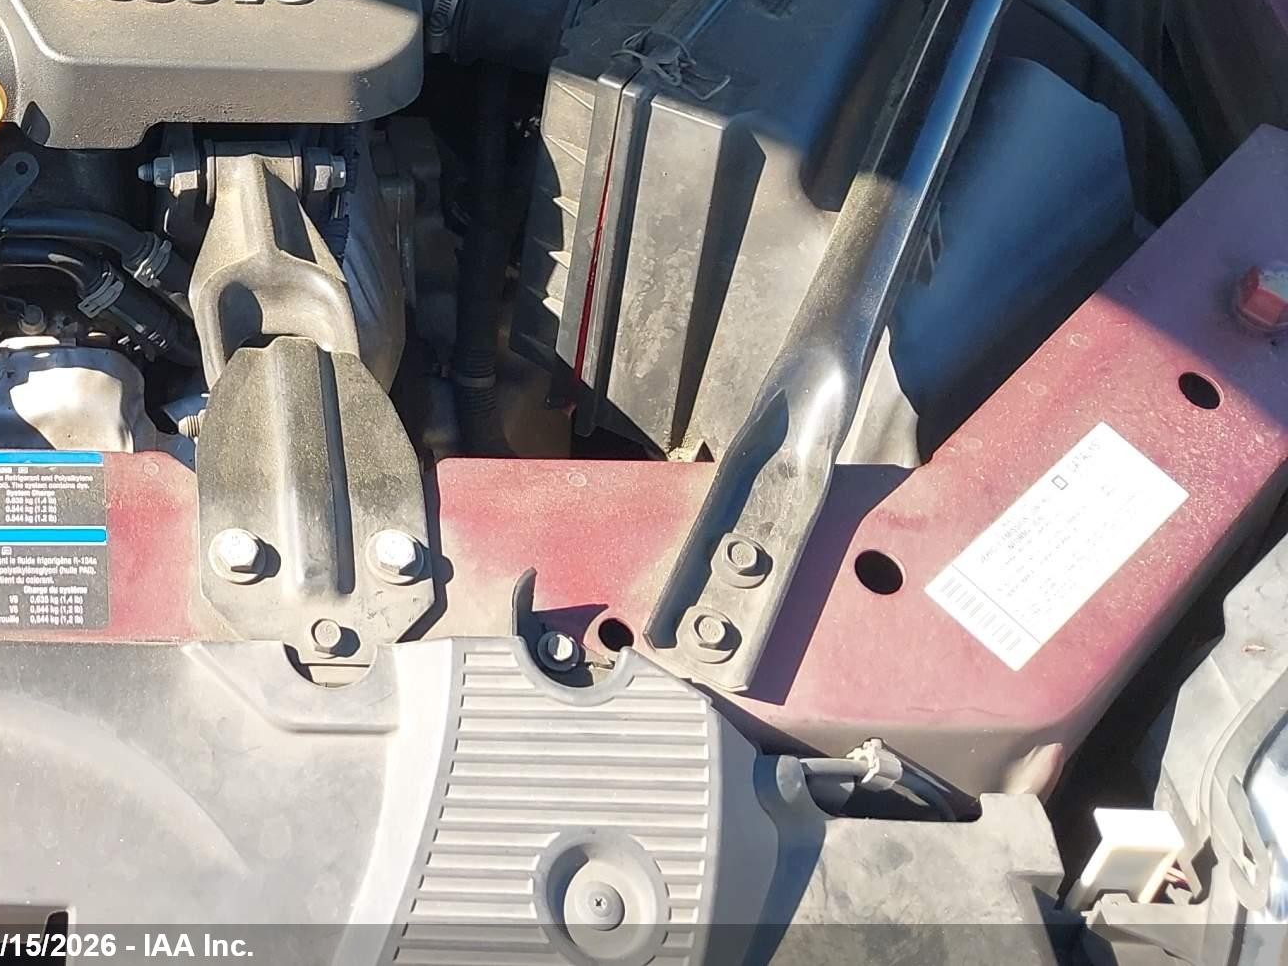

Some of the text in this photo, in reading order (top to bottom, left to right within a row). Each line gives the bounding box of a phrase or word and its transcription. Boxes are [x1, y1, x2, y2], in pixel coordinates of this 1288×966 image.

[5, 474, 40, 483] Refrigerant
[41, 474, 53, 482] and
[24, 482, 48, 490] system
[24, 497, 34, 506] kg
[24, 505, 34, 514] kg
[24, 514, 34, 524] kg
[9, 556, 16, 564] le
[17, 556, 35, 565] fluide
[16, 575, 25, 584] du
[50, 595, 59, 605] kg
[50, 605, 59, 615] kg
[50, 615, 59, 625] kg
